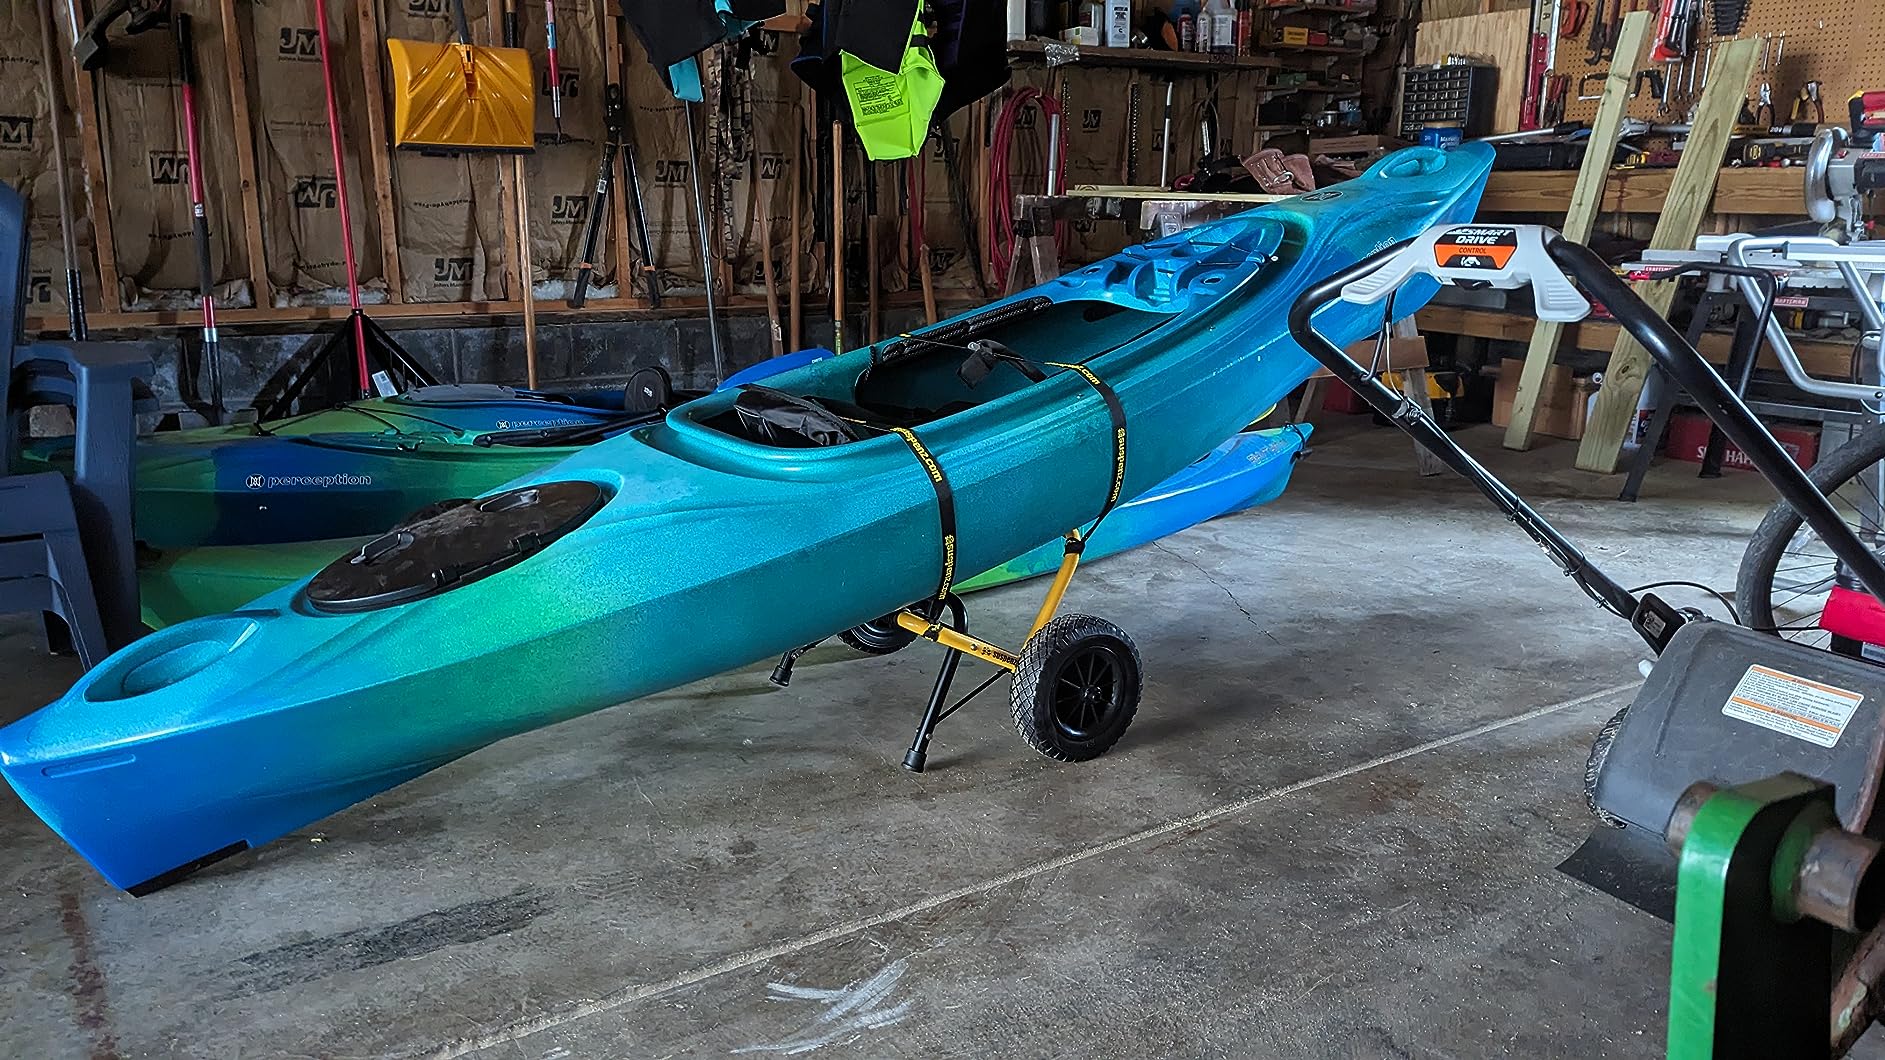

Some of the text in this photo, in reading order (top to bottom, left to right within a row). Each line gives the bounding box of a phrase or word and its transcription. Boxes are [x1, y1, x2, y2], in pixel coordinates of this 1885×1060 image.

[279, 28, 321, 55] JM
[0, 116, 33, 143] M
[552, 196, 589, 218] JM
[1455, 236, 1499, 244] DRIVE
[1464, 228, 1514, 236] SMART
[435, 257, 474, 282] JM
[512, 418, 584, 428] perception
[267, 473, 372, 489] perception
